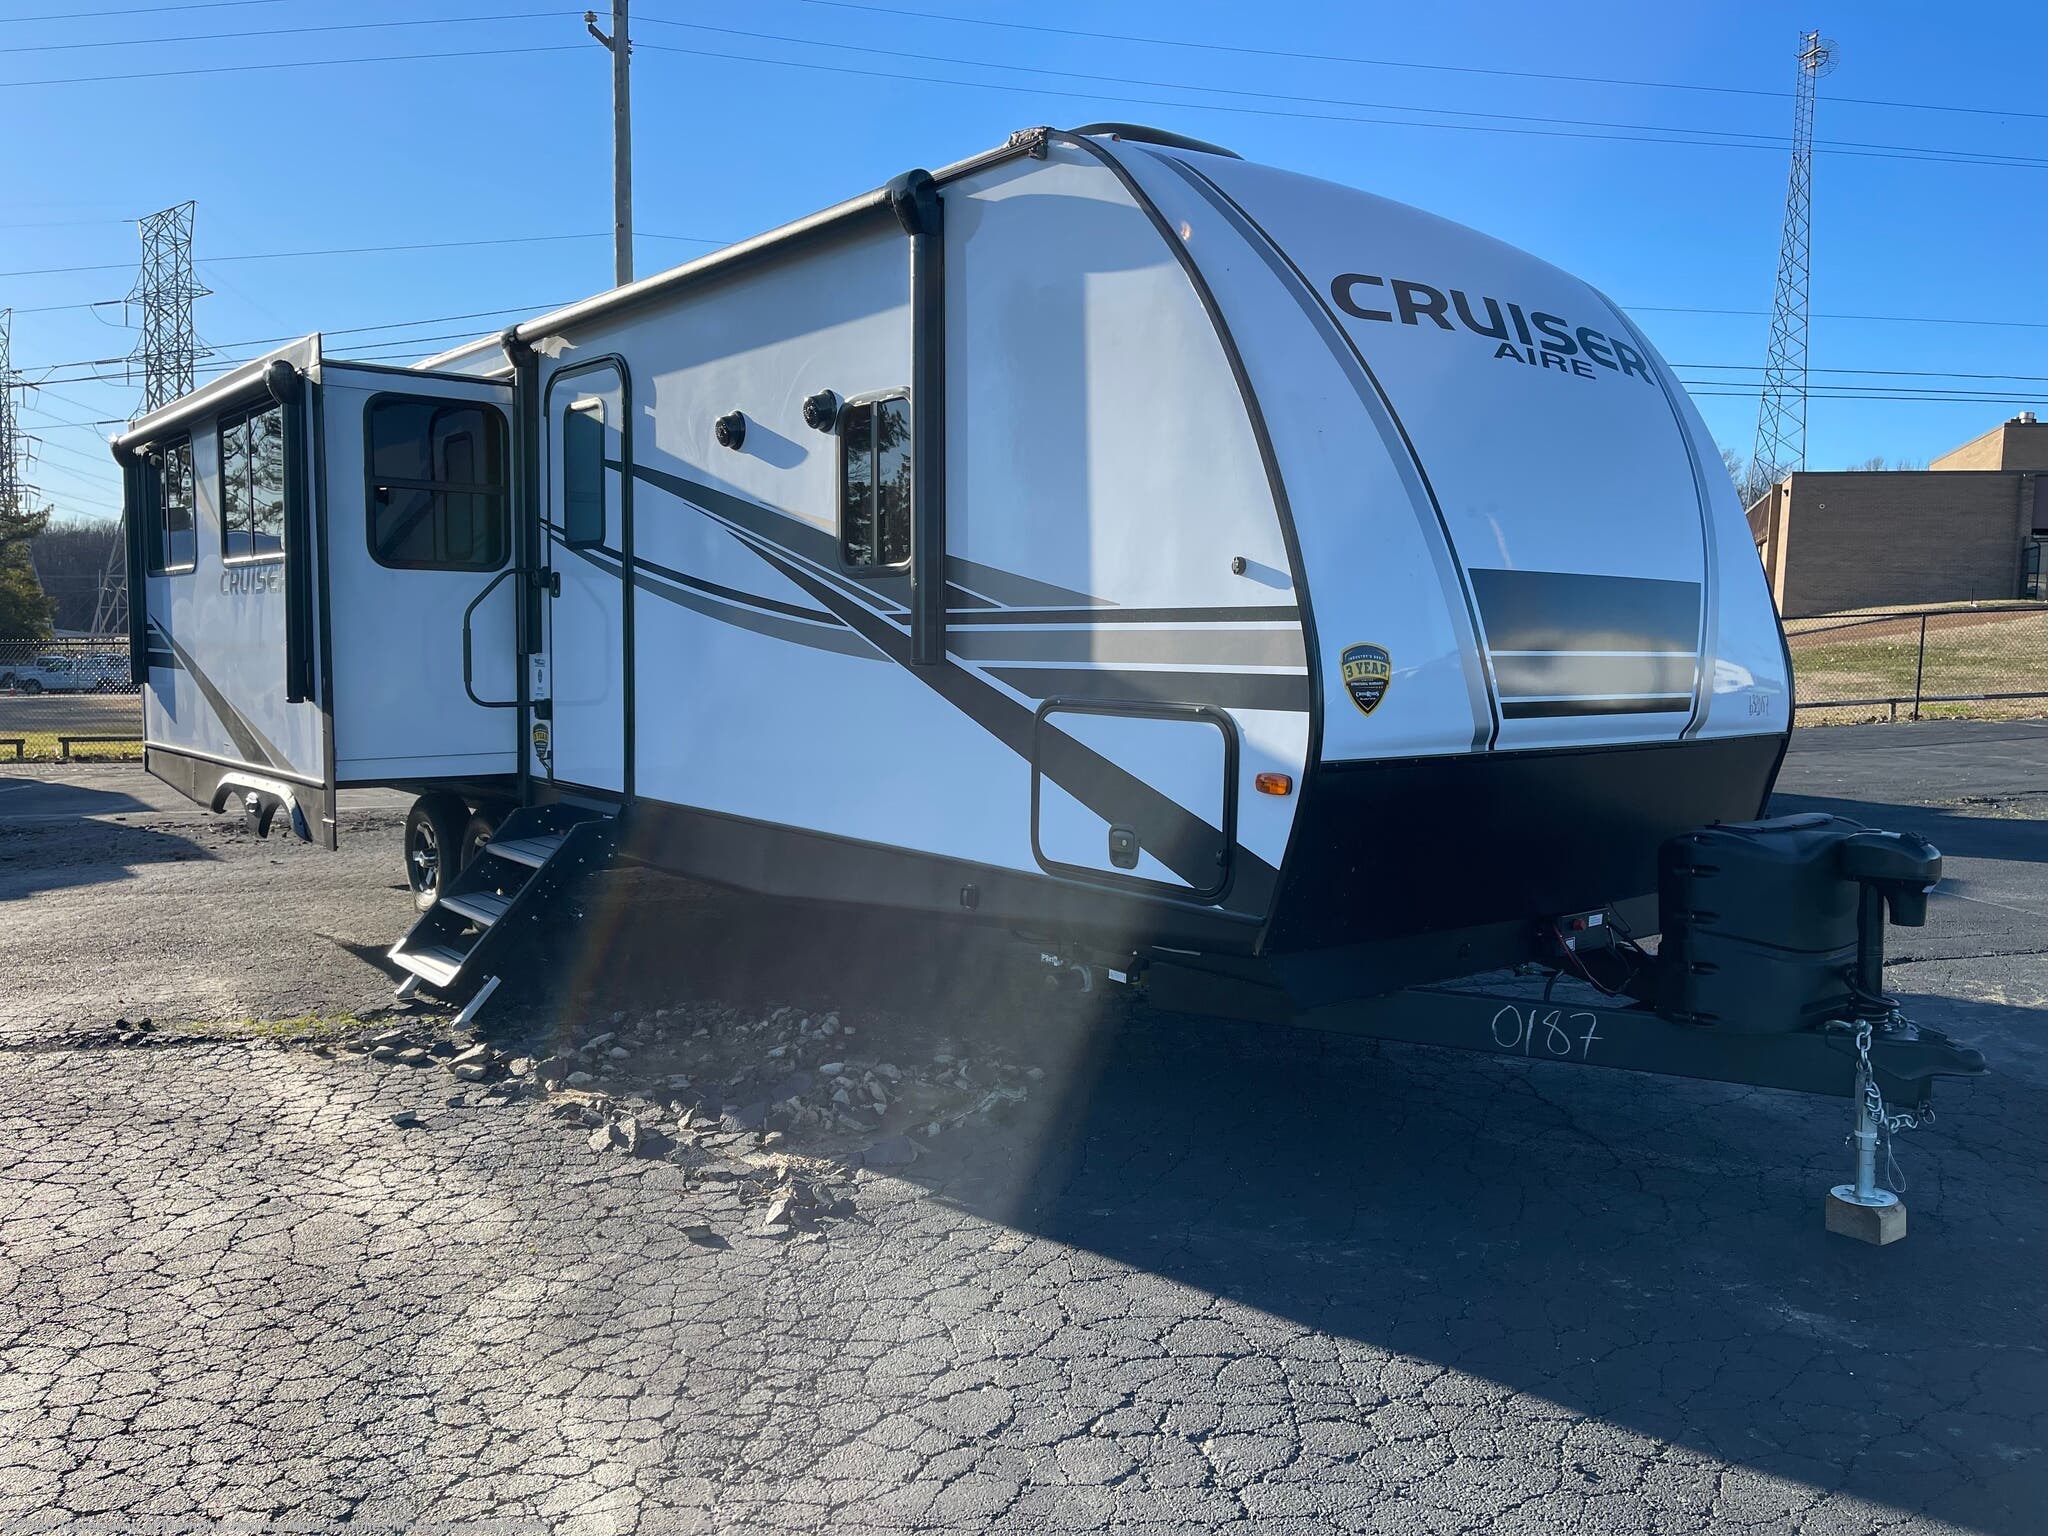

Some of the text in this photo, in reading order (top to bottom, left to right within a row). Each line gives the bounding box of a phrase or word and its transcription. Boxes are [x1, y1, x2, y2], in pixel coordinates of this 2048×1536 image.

[1330, 272, 1655, 386] CRUISER
[1494, 342, 1597, 380] AIRE
[1346, 662, 1387, 678] 3 YEAR
[1491, 1004, 1605, 1061] 0187
